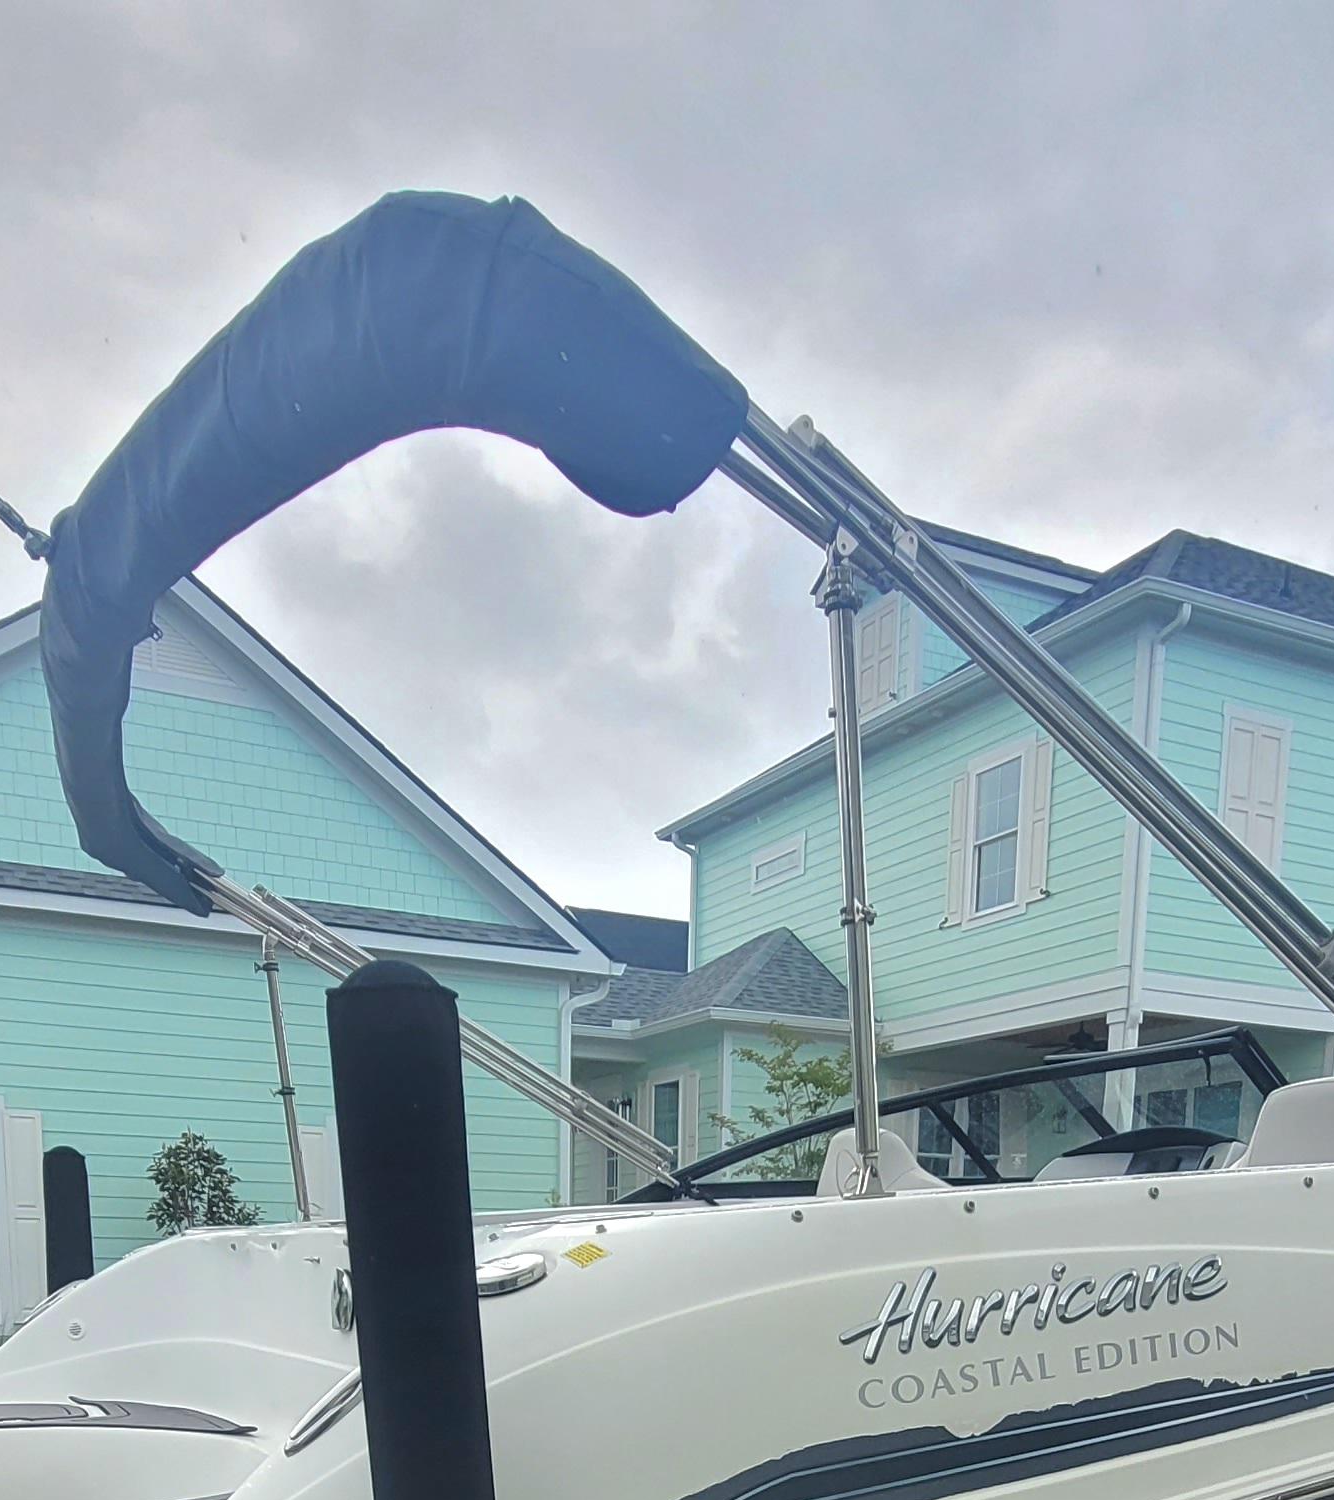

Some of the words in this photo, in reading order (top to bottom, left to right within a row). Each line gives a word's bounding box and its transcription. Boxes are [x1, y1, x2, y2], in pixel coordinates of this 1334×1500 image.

[839, 1254, 1228, 1364] Hurricane
[858, 1352, 1056, 1409] COASTAL
[1075, 1322, 1239, 1374] EDITION
